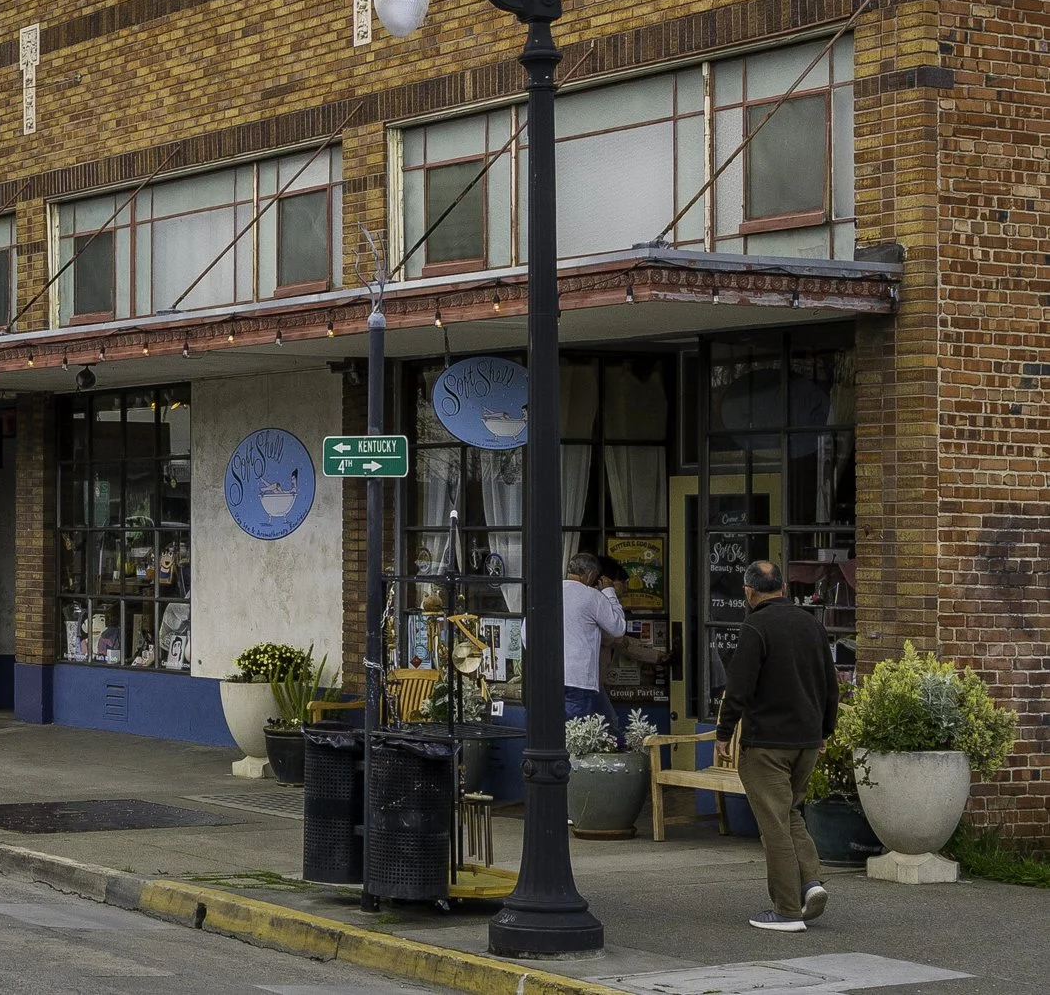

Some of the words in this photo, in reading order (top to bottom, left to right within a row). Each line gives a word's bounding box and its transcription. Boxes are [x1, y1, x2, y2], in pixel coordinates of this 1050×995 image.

[442, 365, 476, 417] Soft
[474, 359, 515, 398] Shell
[358, 439, 397, 453] KENTUCKY
[337, 459, 353, 474] 4TH
[710, 565, 733, 573] Beauty
[610, 689, 634, 698] Group
[637, 689, 664, 697] Parties
